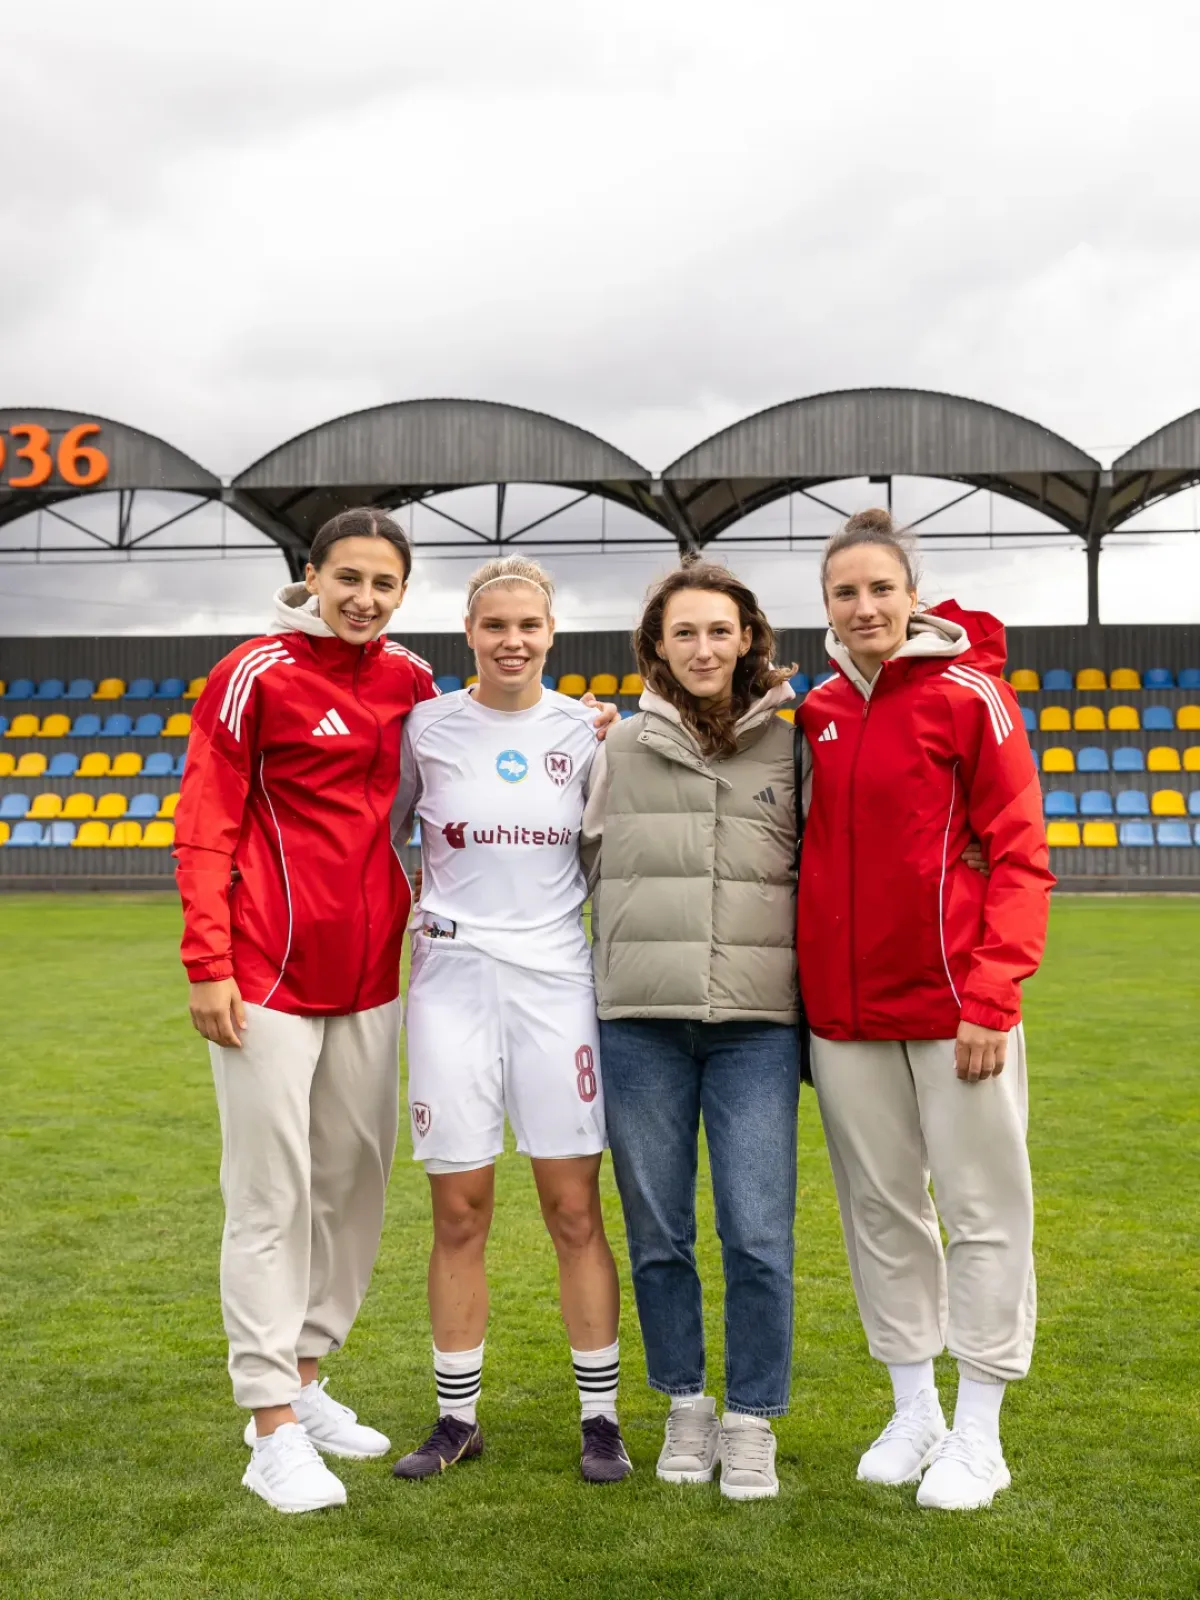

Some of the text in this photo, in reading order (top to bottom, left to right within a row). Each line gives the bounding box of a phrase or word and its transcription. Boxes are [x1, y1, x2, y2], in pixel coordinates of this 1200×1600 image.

[0, 423, 109, 488] 36
[550, 758, 567, 772] M
[473, 825, 572, 846] whitebit
[575, 1044, 597, 1102] 8
[415, 1108, 426, 1124] M
